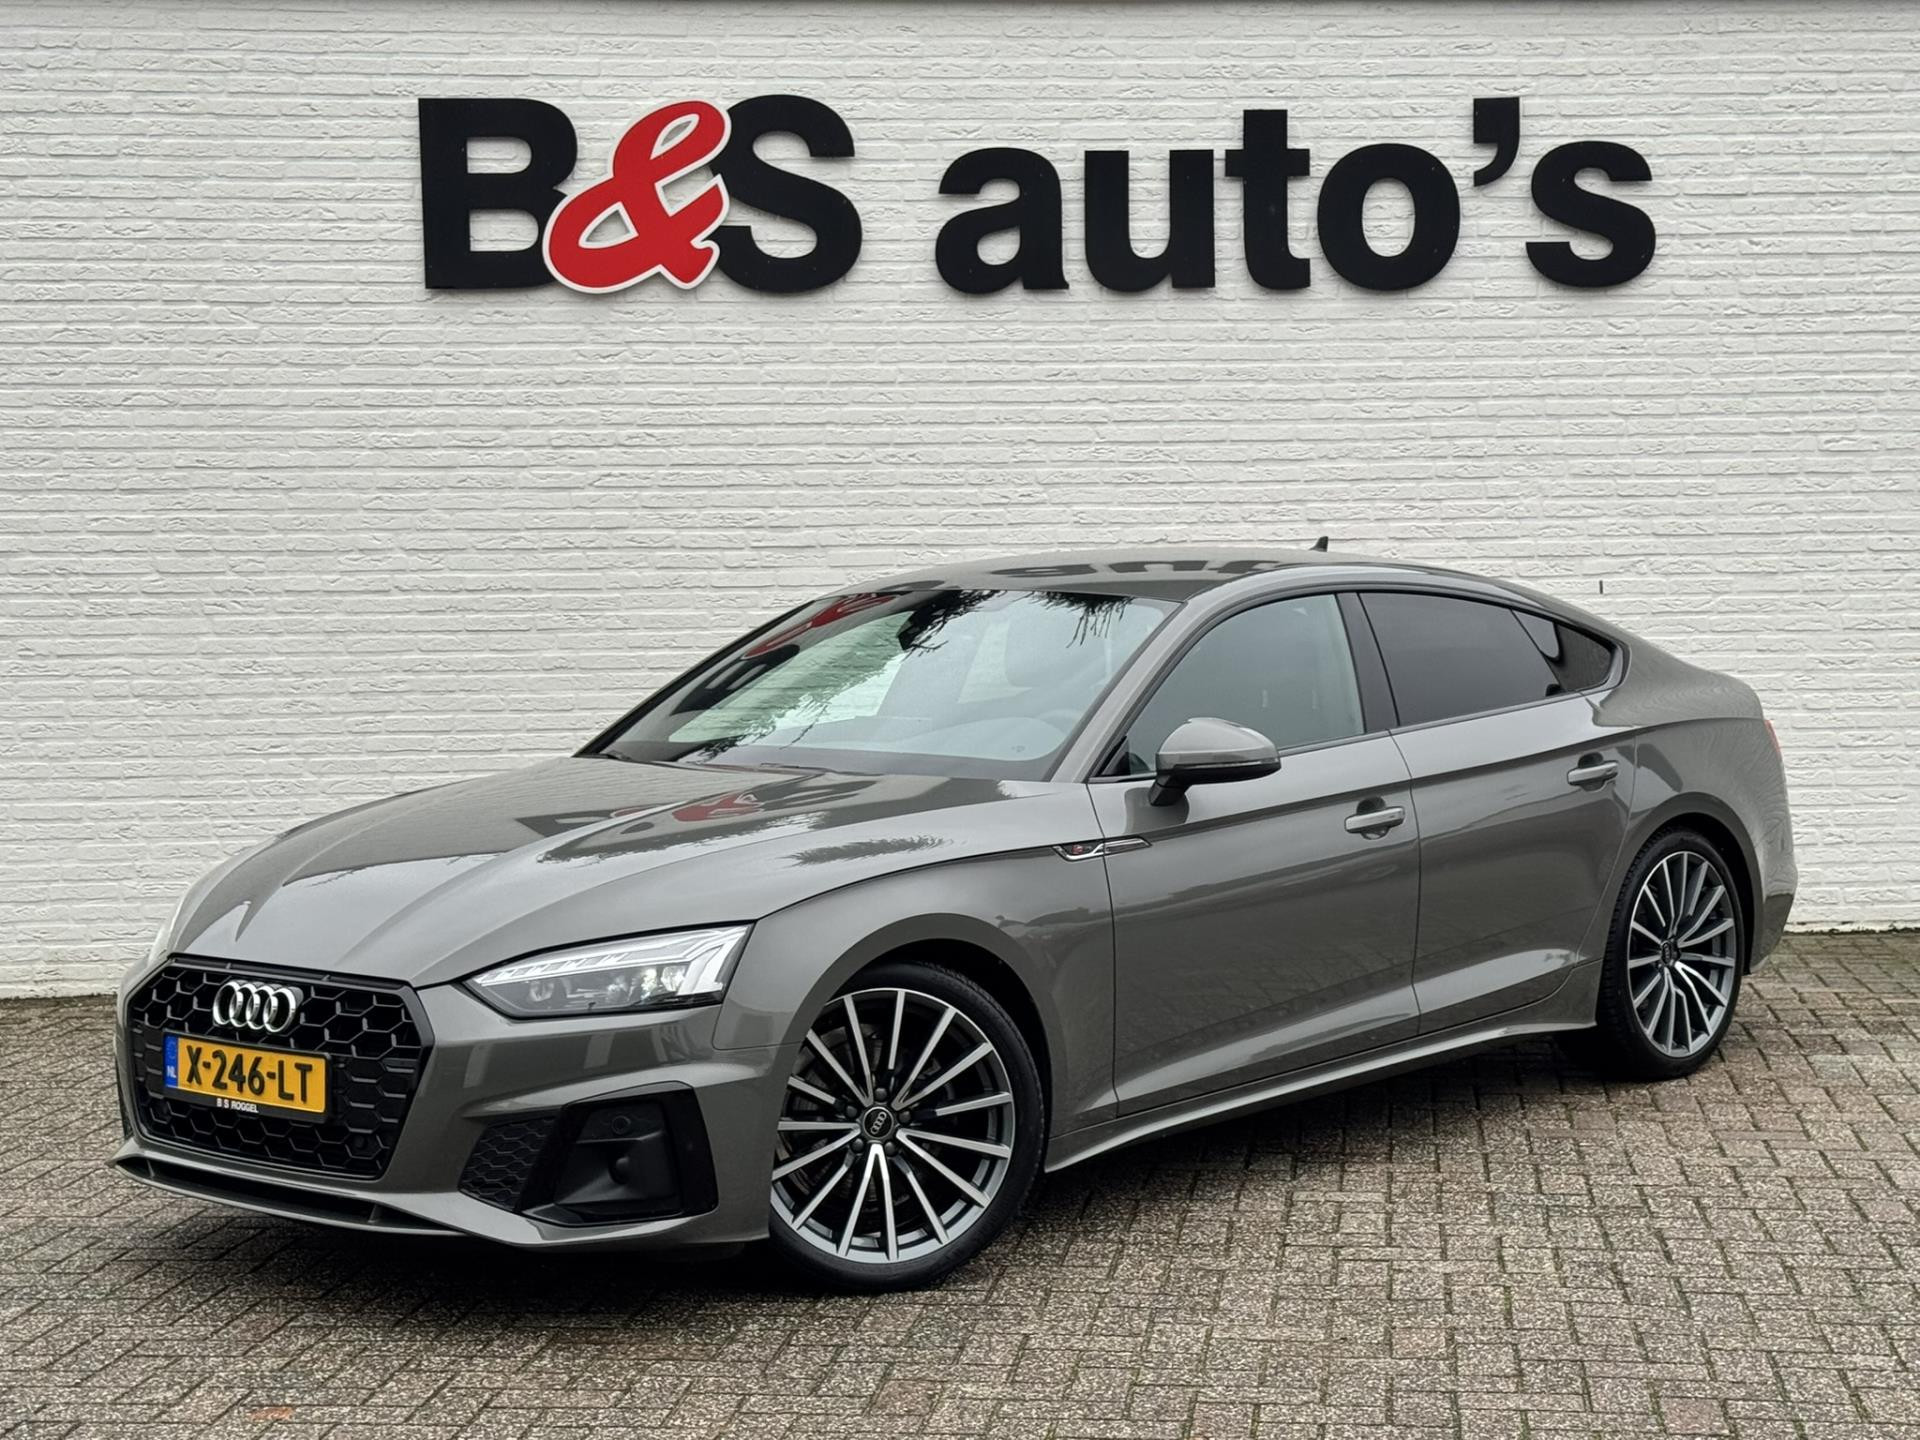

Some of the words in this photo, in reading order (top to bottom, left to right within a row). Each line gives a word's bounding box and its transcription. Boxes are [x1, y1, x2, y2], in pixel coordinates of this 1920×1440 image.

[418, 94, 862, 295] B&S
[935, 97, 1657, 293] auto's
[167, 1065, 177, 1079] NL
[186, 1045, 313, 1104] X-246-LT
[217, 1097, 222, 1107] B
[224, 1098, 229, 1108] S
[231, 1099, 259, 1113] ROGGEL
